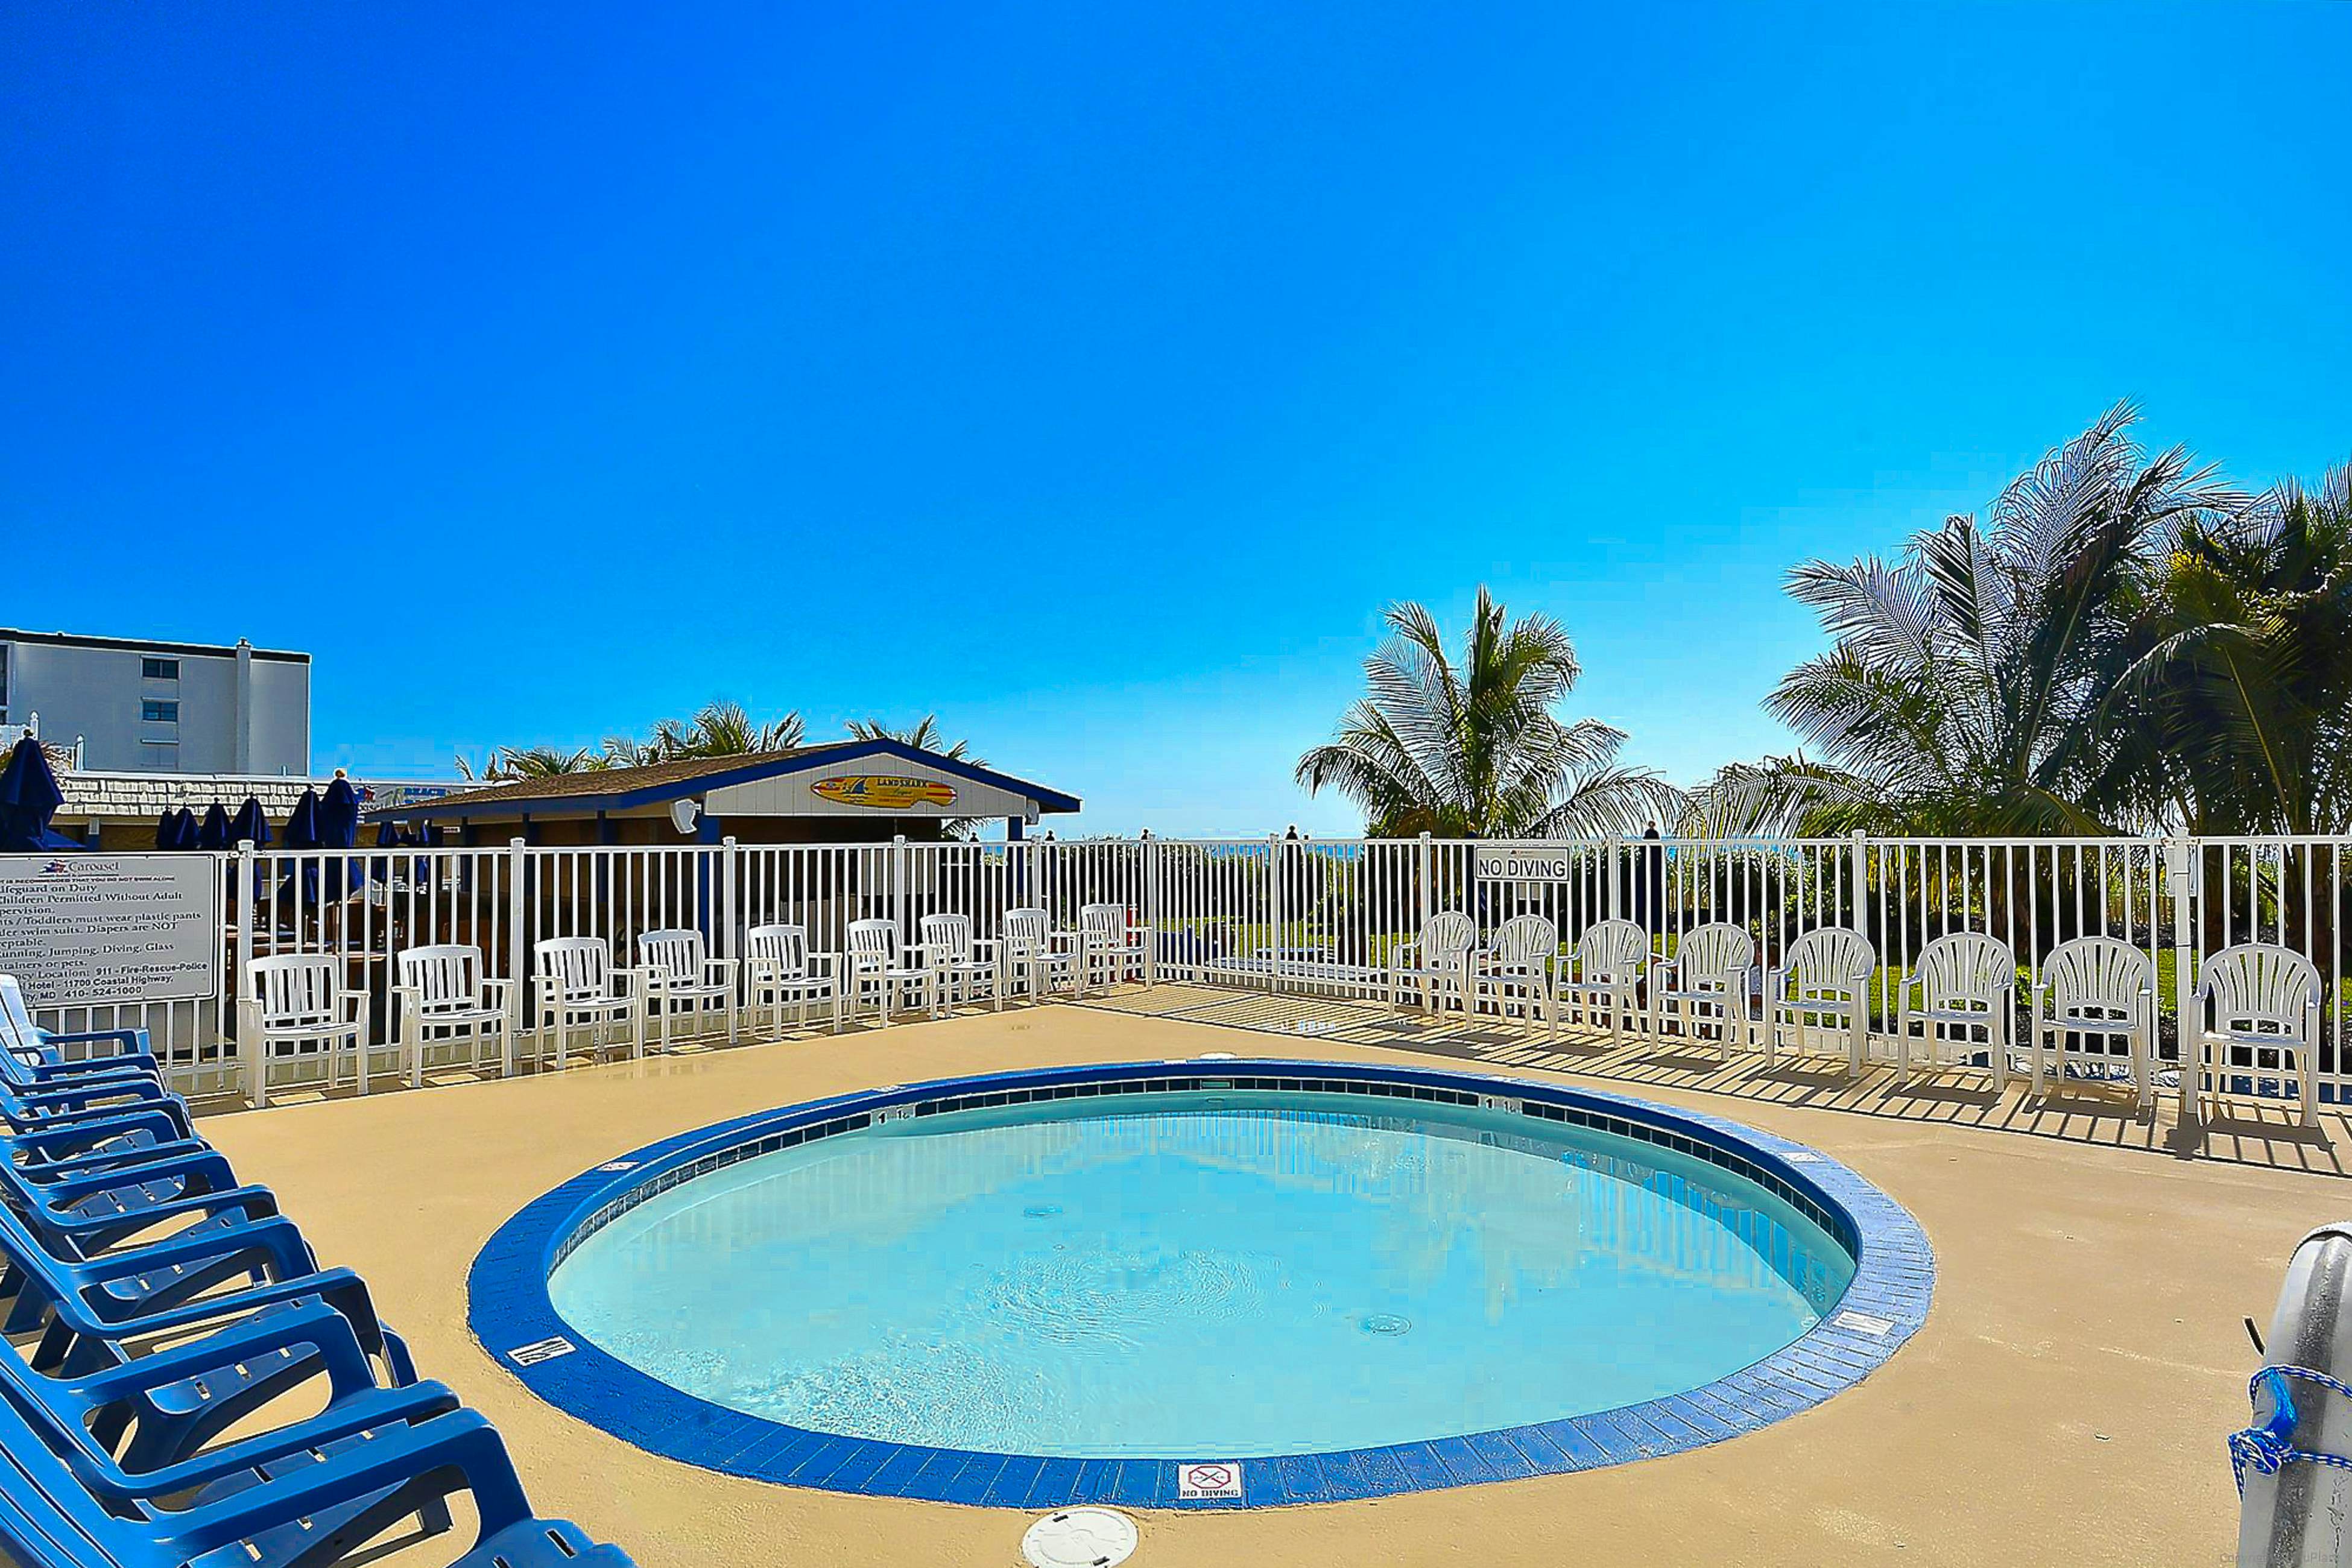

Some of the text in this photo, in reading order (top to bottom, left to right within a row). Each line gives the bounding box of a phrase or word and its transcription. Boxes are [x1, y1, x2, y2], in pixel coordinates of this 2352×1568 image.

[68, 861, 119, 871] Carousel
[1479, 859, 1566, 877] NO DIVING
[0, 884, 48, 895] ifeguard
[69, 884, 97, 893] Duty
[48, 894, 101, 903] Permitted
[106, 893, 150, 902] Without
[153, 891, 183, 901] Adult
[0, 906, 55, 916] pervision.
[24, 916, 72, 925] Toddlers
[76, 915, 103, 923] must
[135, 912, 169, 923] plastic
[172, 911, 201, 921] pants
[21, 928, 50, 936] swim
[54, 926, 83, 934] suits.
[87, 923, 128, 934] Diapers
[131, 923, 149, 932] are
[152, 922, 179, 931] NOT
[145, 943, 174, 952] Glass
[38, 969, 90, 979] Location:
[96, 967, 112, 976] 911
[121, 963, 208, 975] Fire-Rescue-Police
[28, 979, 55, 990] Hotel
[63, 978, 91, 987] 11700
[93, 976, 129, 987] Coastal
[39, 991, 56, 999] MD
[92, 986, 142, 996] 524-1000
